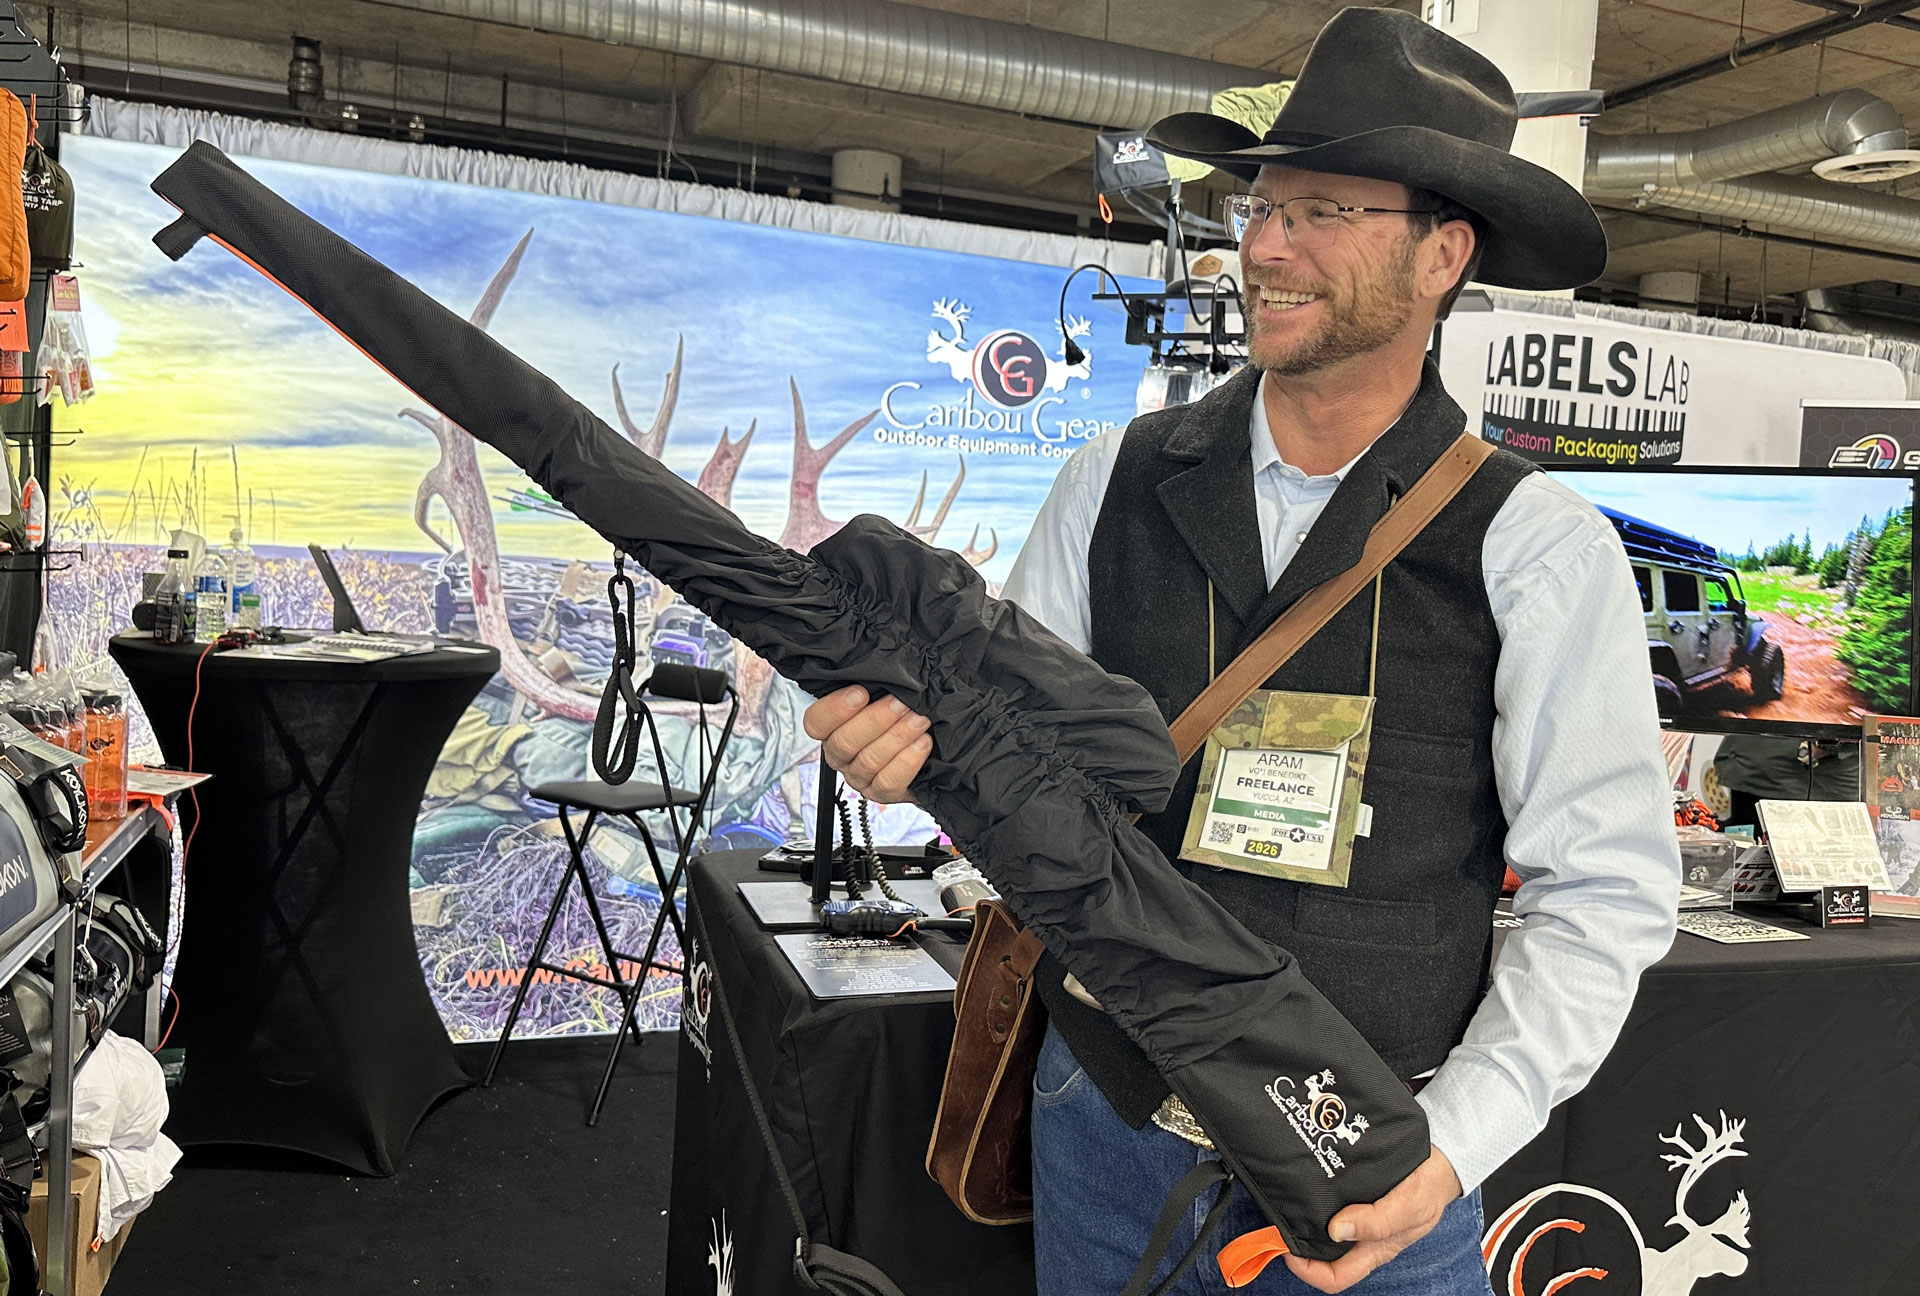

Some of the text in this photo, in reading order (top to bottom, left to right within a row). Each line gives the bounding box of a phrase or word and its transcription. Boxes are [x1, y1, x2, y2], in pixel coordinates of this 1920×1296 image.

[1485, 332, 1690, 405] LABELS LAB
[880, 381, 1117, 443] Caribou Gear
[873, 427, 945, 449] Outdoor
[946, 434, 1039, 457] Equipment
[1484, 419, 1681, 466] Your Custom Packaging Solutions
[1256, 752, 1304, 770] ARAM
[1267, 769, 1308, 781] BENEDIKT
[1236, 776, 1316, 797] FREELANCE
[1253, 792, 1296, 805] YUCCA, AZ
[59, 767, 87, 839] KOYUKON
[1253, 808, 1286, 822] MEDIA
[1247, 841, 1279, 856] 2026
[1264, 1084, 1335, 1178] Outdoor Equipment Company
[1273, 1076, 1345, 1169] Caribou Gear
